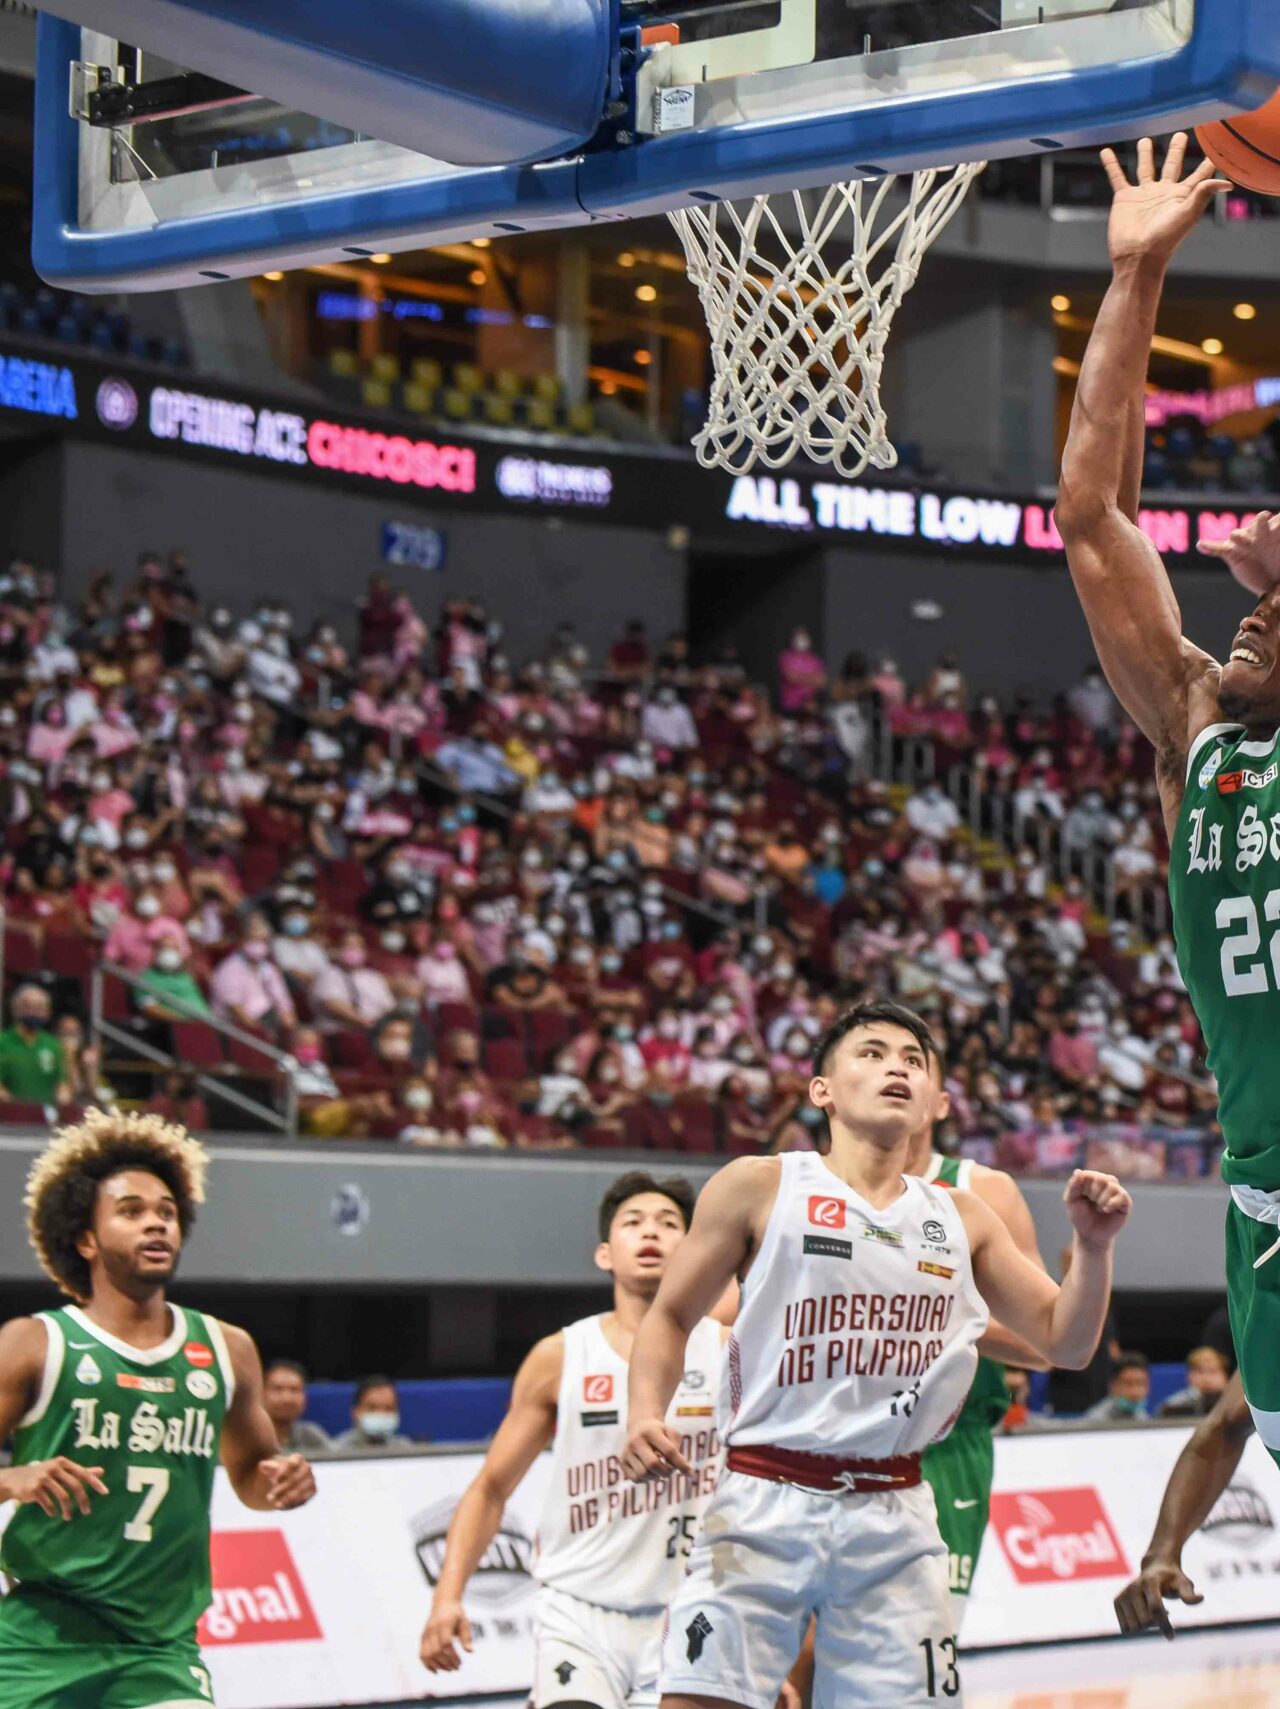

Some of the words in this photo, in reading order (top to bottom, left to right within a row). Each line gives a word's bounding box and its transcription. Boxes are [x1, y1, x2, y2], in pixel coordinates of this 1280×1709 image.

[150, 386, 254, 455] OPENING
[307, 420, 476, 493] CHICOSCI
[726, 475, 811, 525] ALL
[811, 482, 915, 536] TIME
[919, 493, 1022, 546] LOW
[1242, 764, 1277, 787] ICTSI
[1186, 806, 1224, 875] La
[778, 1343, 815, 1388] NG
[72, 1397, 120, 1450] La
[127, 1401, 214, 1458] Salle
[567, 1427, 721, 1497] UNIBDAD
[123, 1465, 170, 1542] 7
[569, 1498, 599, 1534] NG
[666, 1515, 697, 1559] 25
[205, 1571, 302, 1639] gnal
[918, 1634, 960, 1698] 13
